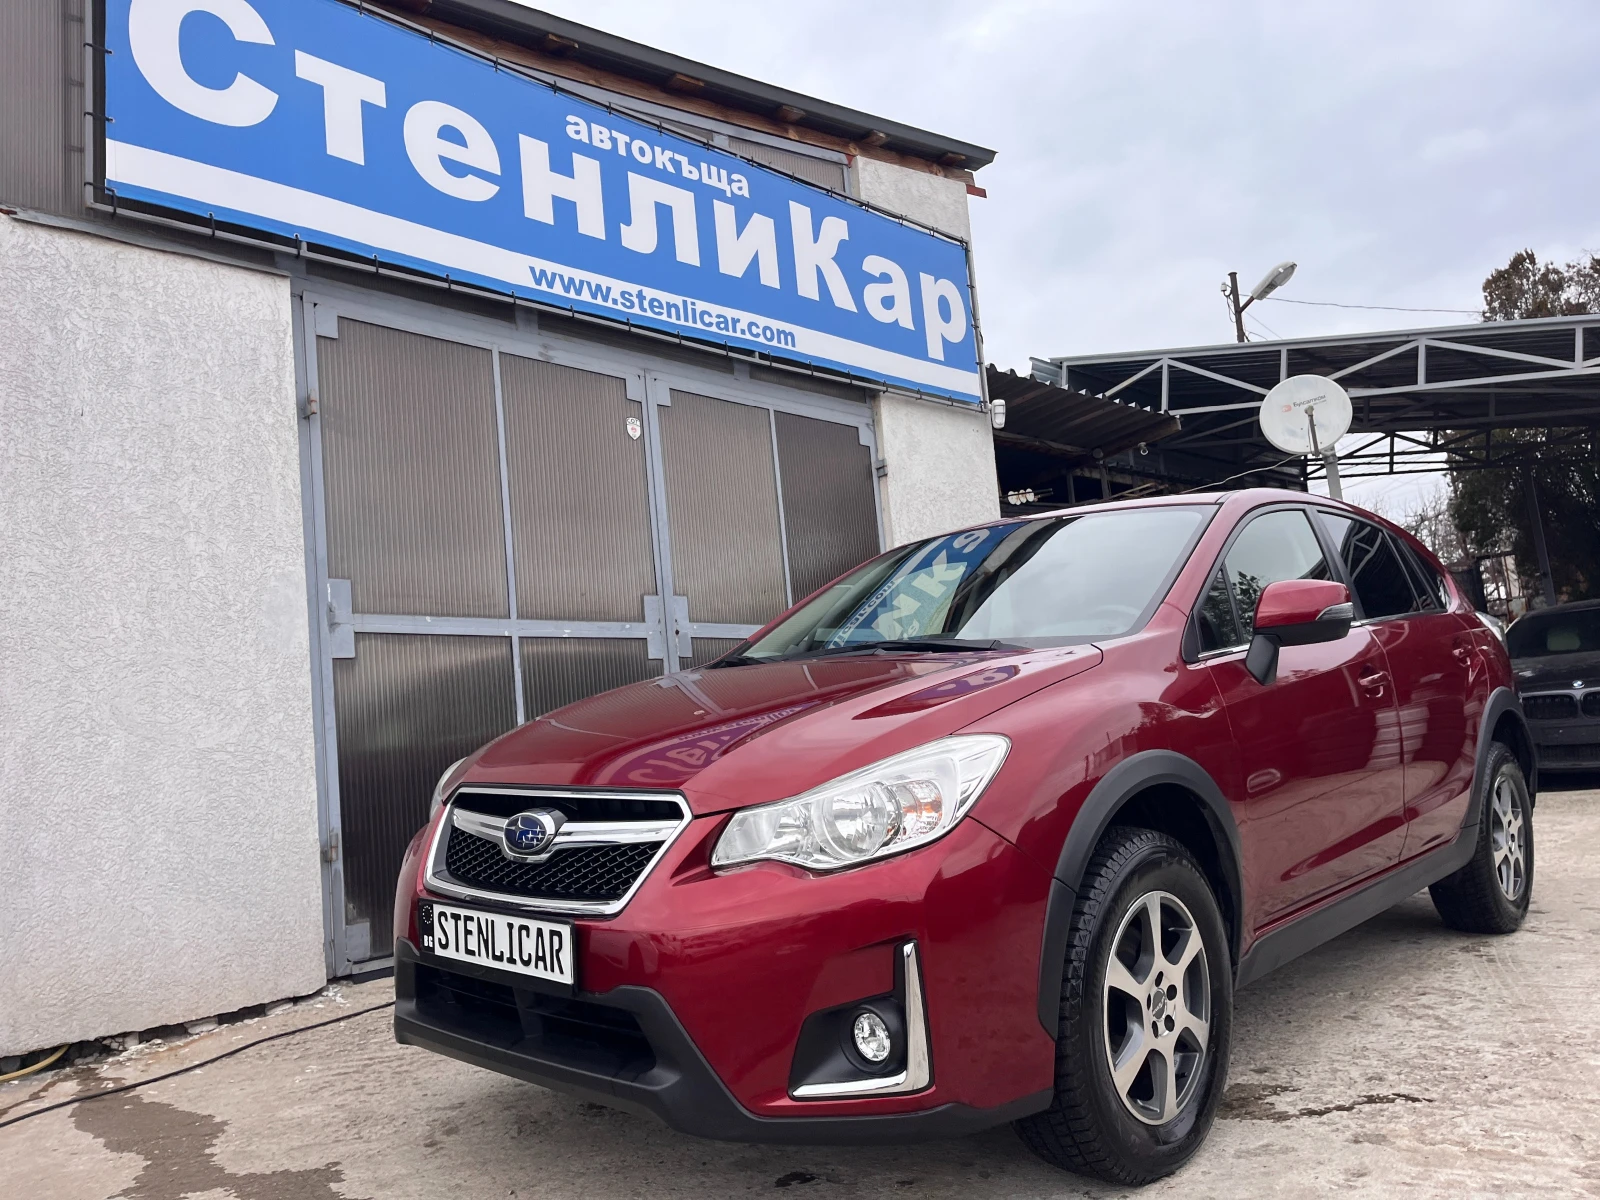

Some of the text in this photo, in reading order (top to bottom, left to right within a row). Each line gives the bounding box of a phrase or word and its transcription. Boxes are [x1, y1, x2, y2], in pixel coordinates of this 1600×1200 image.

[128, 0, 968, 362] СтенлиКар
[565, 114, 750, 199] автокъща
[528, 265, 797, 350] www.stenlicar.com
[423, 934, 433, 948] BG
[437, 910, 565, 975] STENLICAR
